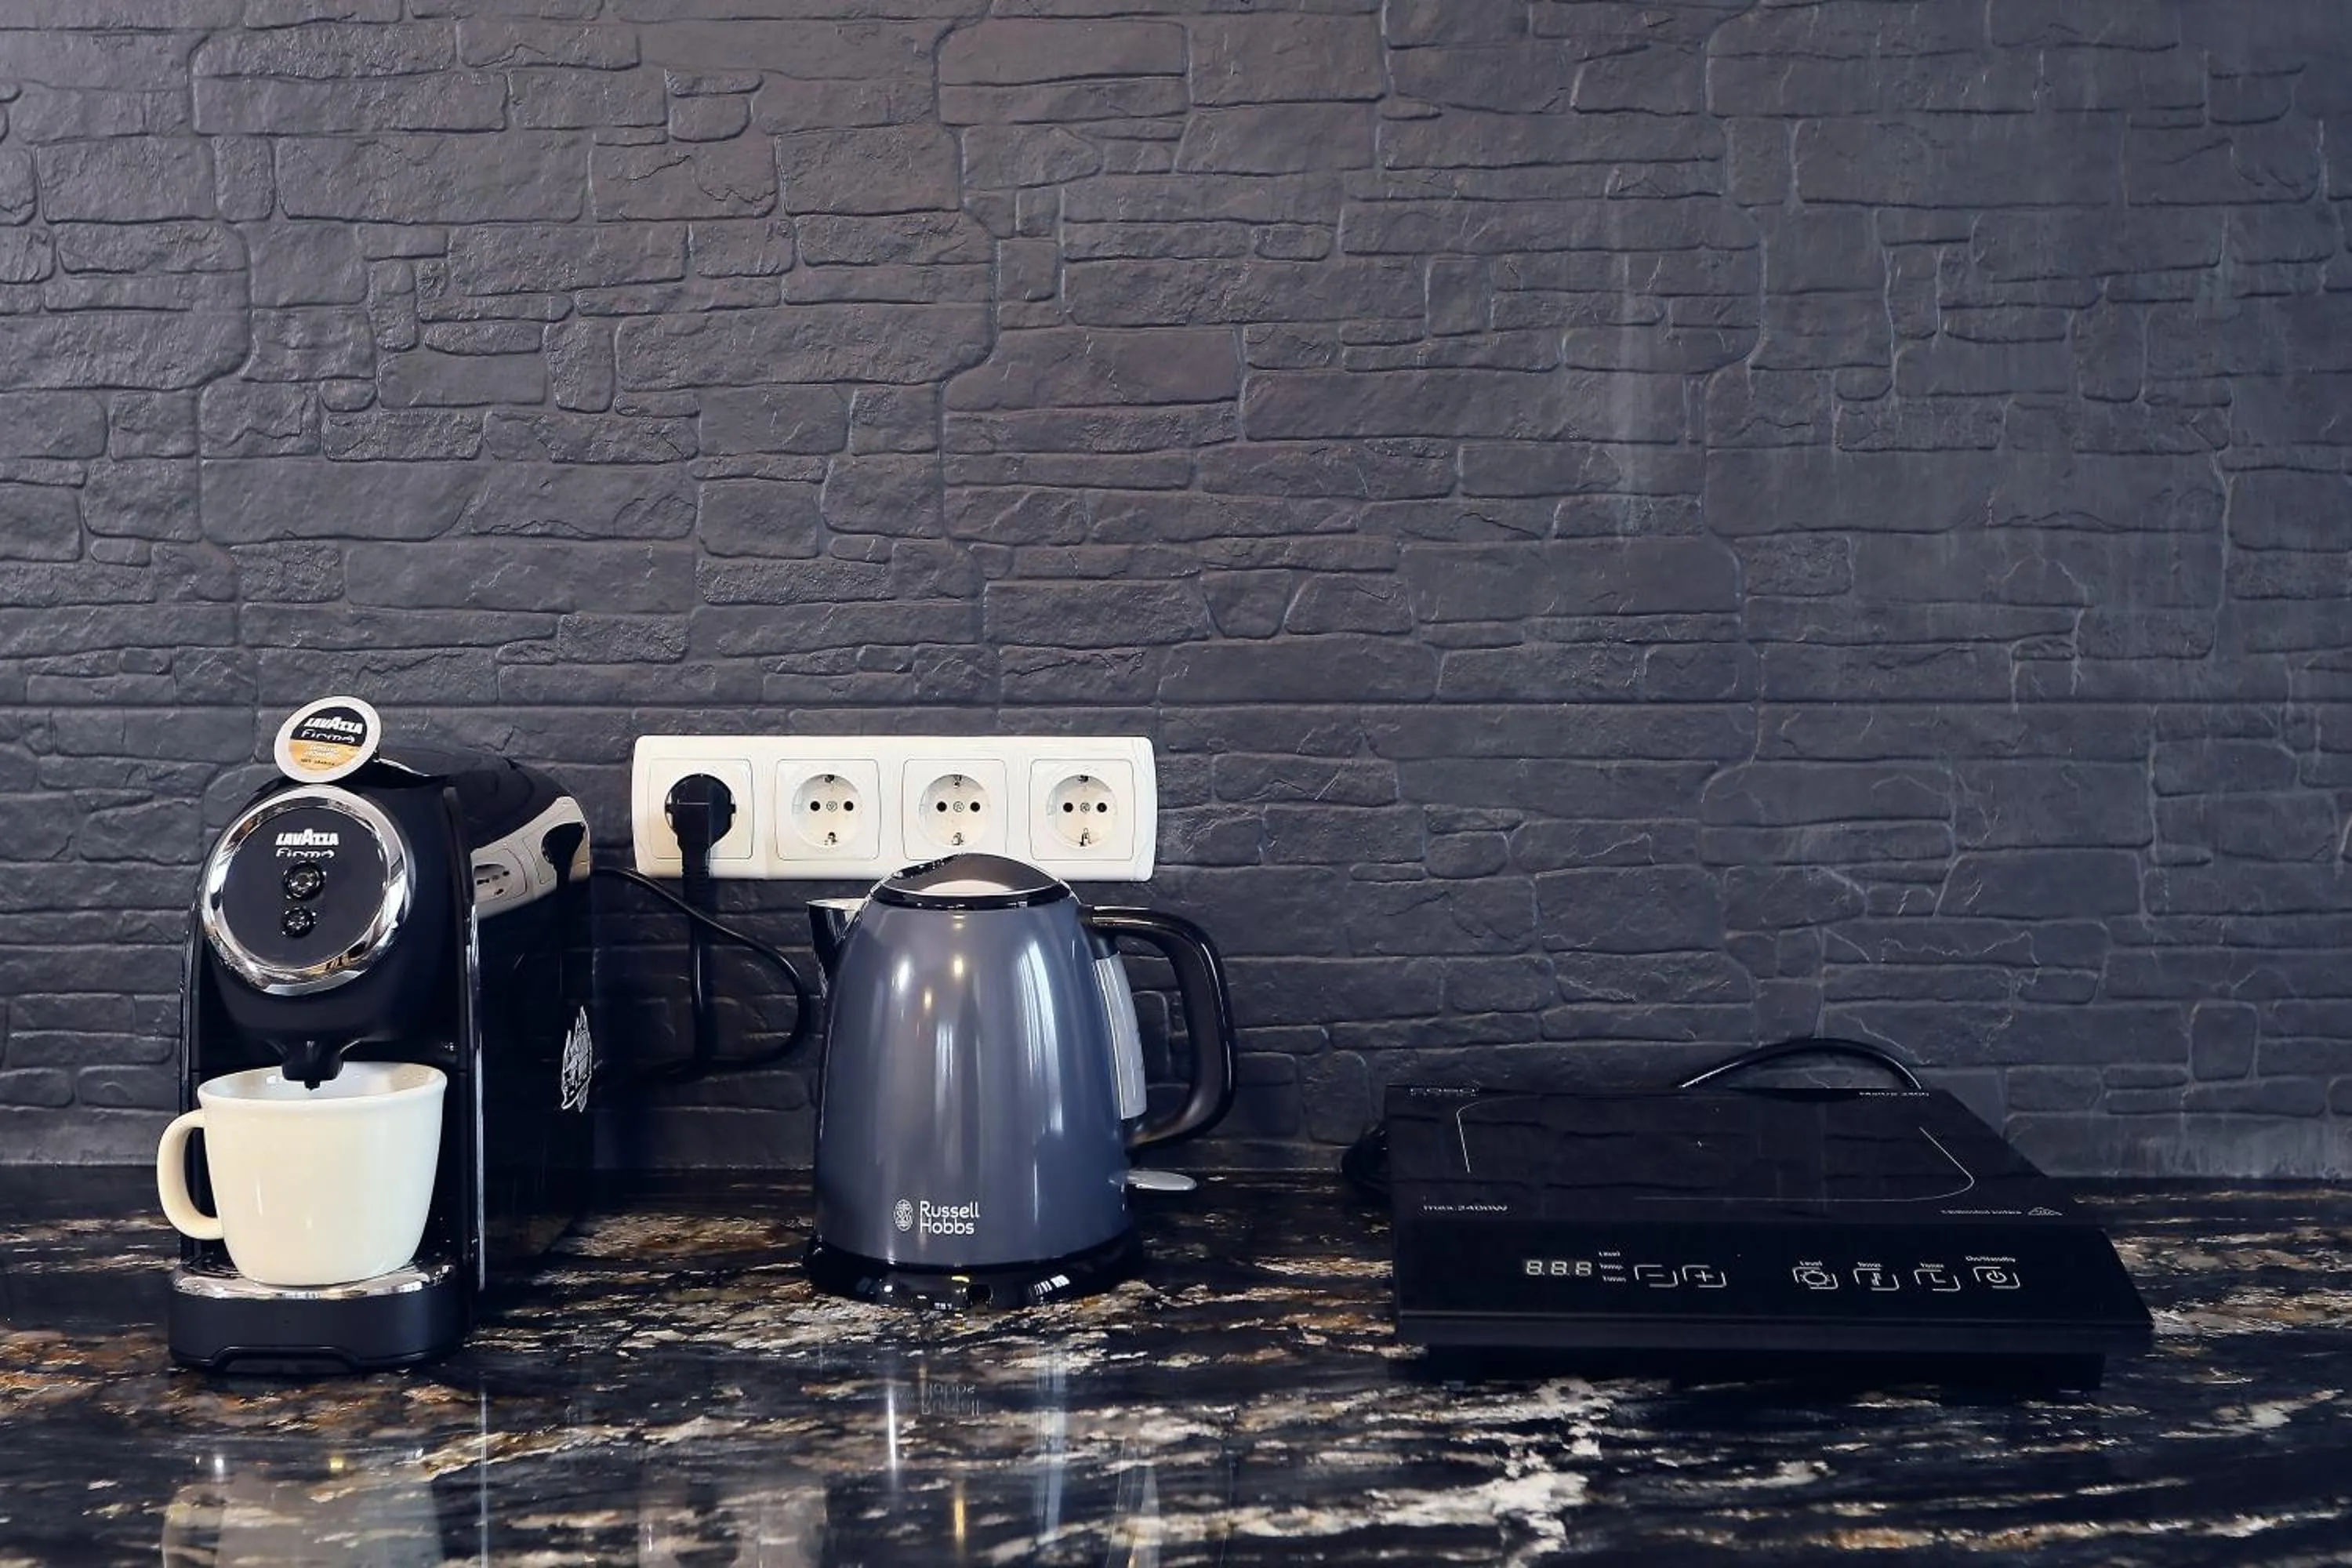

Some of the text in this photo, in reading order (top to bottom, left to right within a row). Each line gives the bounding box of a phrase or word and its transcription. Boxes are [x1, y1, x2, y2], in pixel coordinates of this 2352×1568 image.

[304, 717, 363, 735] LAVAZZA
[275, 828, 339, 846] LAVAZZA
[920, 1200, 980, 1218] Russell
[920, 1218, 975, 1234] Hobbs
